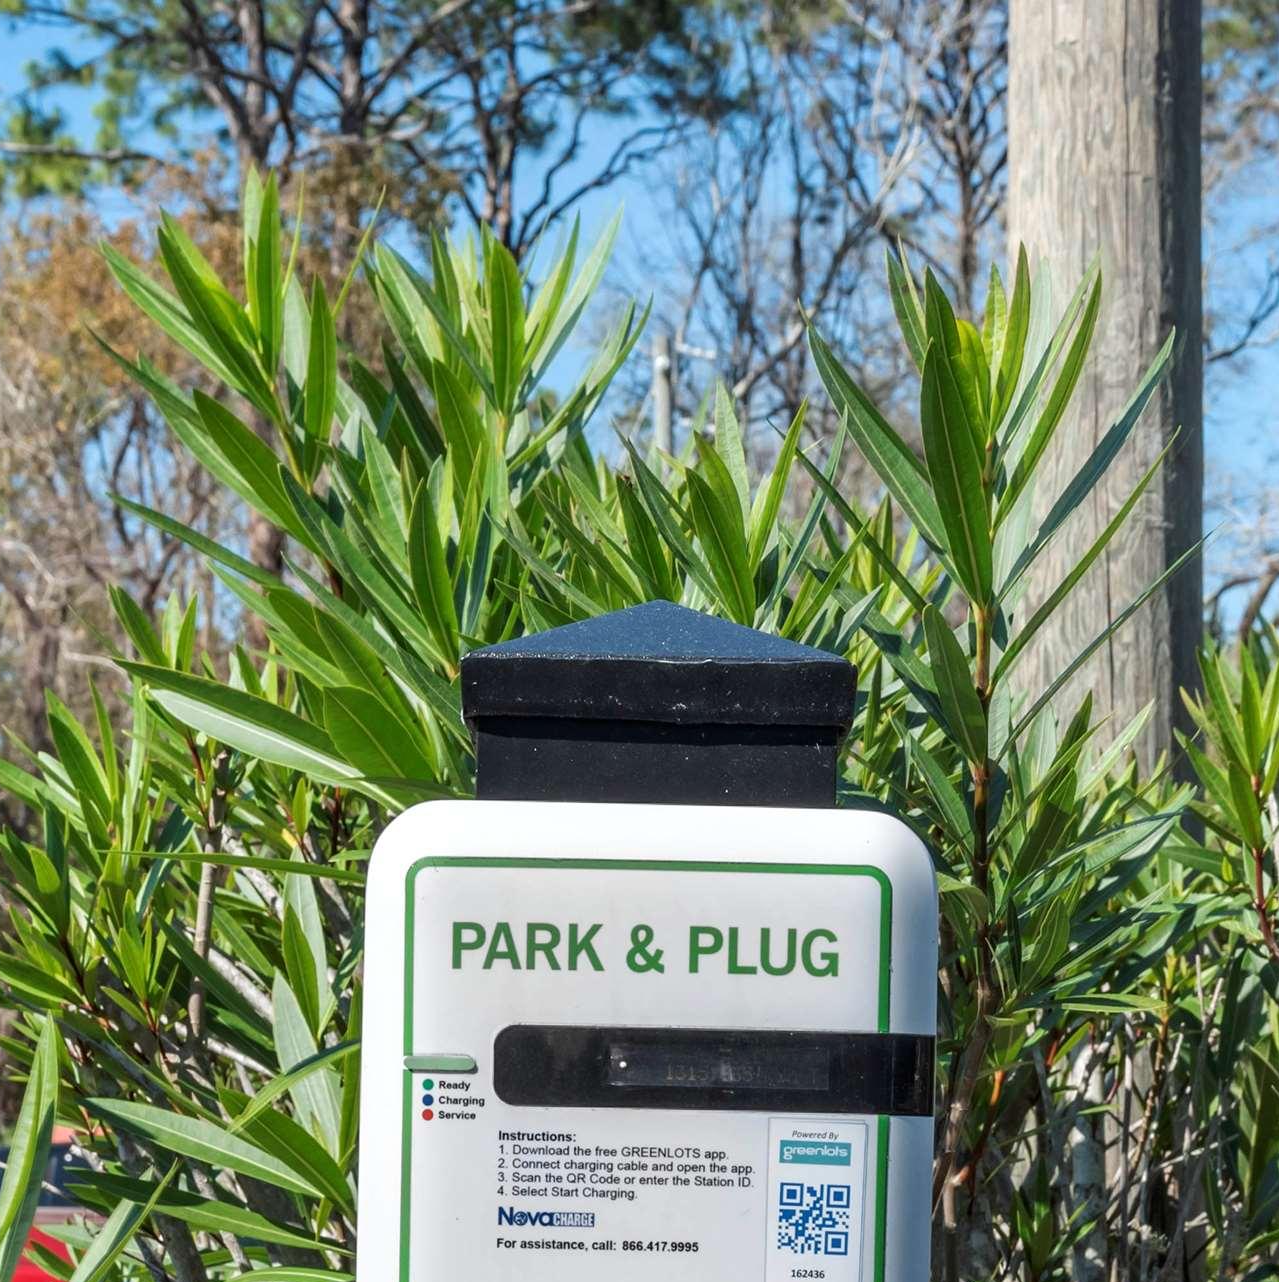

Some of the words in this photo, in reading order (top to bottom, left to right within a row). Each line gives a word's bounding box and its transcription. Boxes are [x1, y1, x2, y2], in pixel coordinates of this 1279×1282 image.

[451, 921, 605, 971] PARK
[626, 924, 665, 973] &
[688, 925, 840, 977] PLUG
[438, 1080, 470, 1091] Ready
[438, 1095, 485, 1107] Charging
[438, 1110, 476, 1120] Service
[498, 1130, 577, 1142] Instructions:
[792, 1130, 827, 1139] Powered
[828, 1131, 839, 1140] By
[499, 1145, 509, 1155] 1.
[512, 1144, 570, 1156] Download
[574, 1146, 591, 1157] the
[595, 1146, 617, 1157] free
[621, 1147, 701, 1158] GREENLOTS
[704, 1150, 729, 1161] app.
[782, 1145, 849, 1161] greenlots
[498, 1158, 509, 1169] 2.
[512, 1158, 561, 1169] Connect
[564, 1159, 614, 1173] charging
[617, 1161, 648, 1171] cable
[652, 1162, 673, 1172] and
[677, 1164, 705, 1174] open
[709, 1163, 727, 1173] the
[731, 1165, 756, 1175] app.
[498, 1172, 509, 1183] 3.
[512, 1172, 541, 1183] Scan
[545, 1173, 563, 1183] the
[566, 1173, 586, 1184] QR
[589, 1173, 620, 1184] Code
[624, 1176, 636, 1185] or
[639, 1176, 669, 1186] enter
[673, 1176, 690, 1186] the
[694, 1176, 734, 1187] Station
[738, 1177, 754, 1188] ID.
[497, 1186, 508, 1197] 4.
[512, 1186, 548, 1197] Select
[551, 1187, 579, 1197] Start
[582, 1187, 638, 1201] Charging.
[497, 1238, 517, 1249] For
[520, 1239, 588, 1252] assistance,
[592, 1240, 616, 1251] call:
[622, 1240, 699, 1252] 866.417.9995
[791, 1269, 825, 1279] 162436
